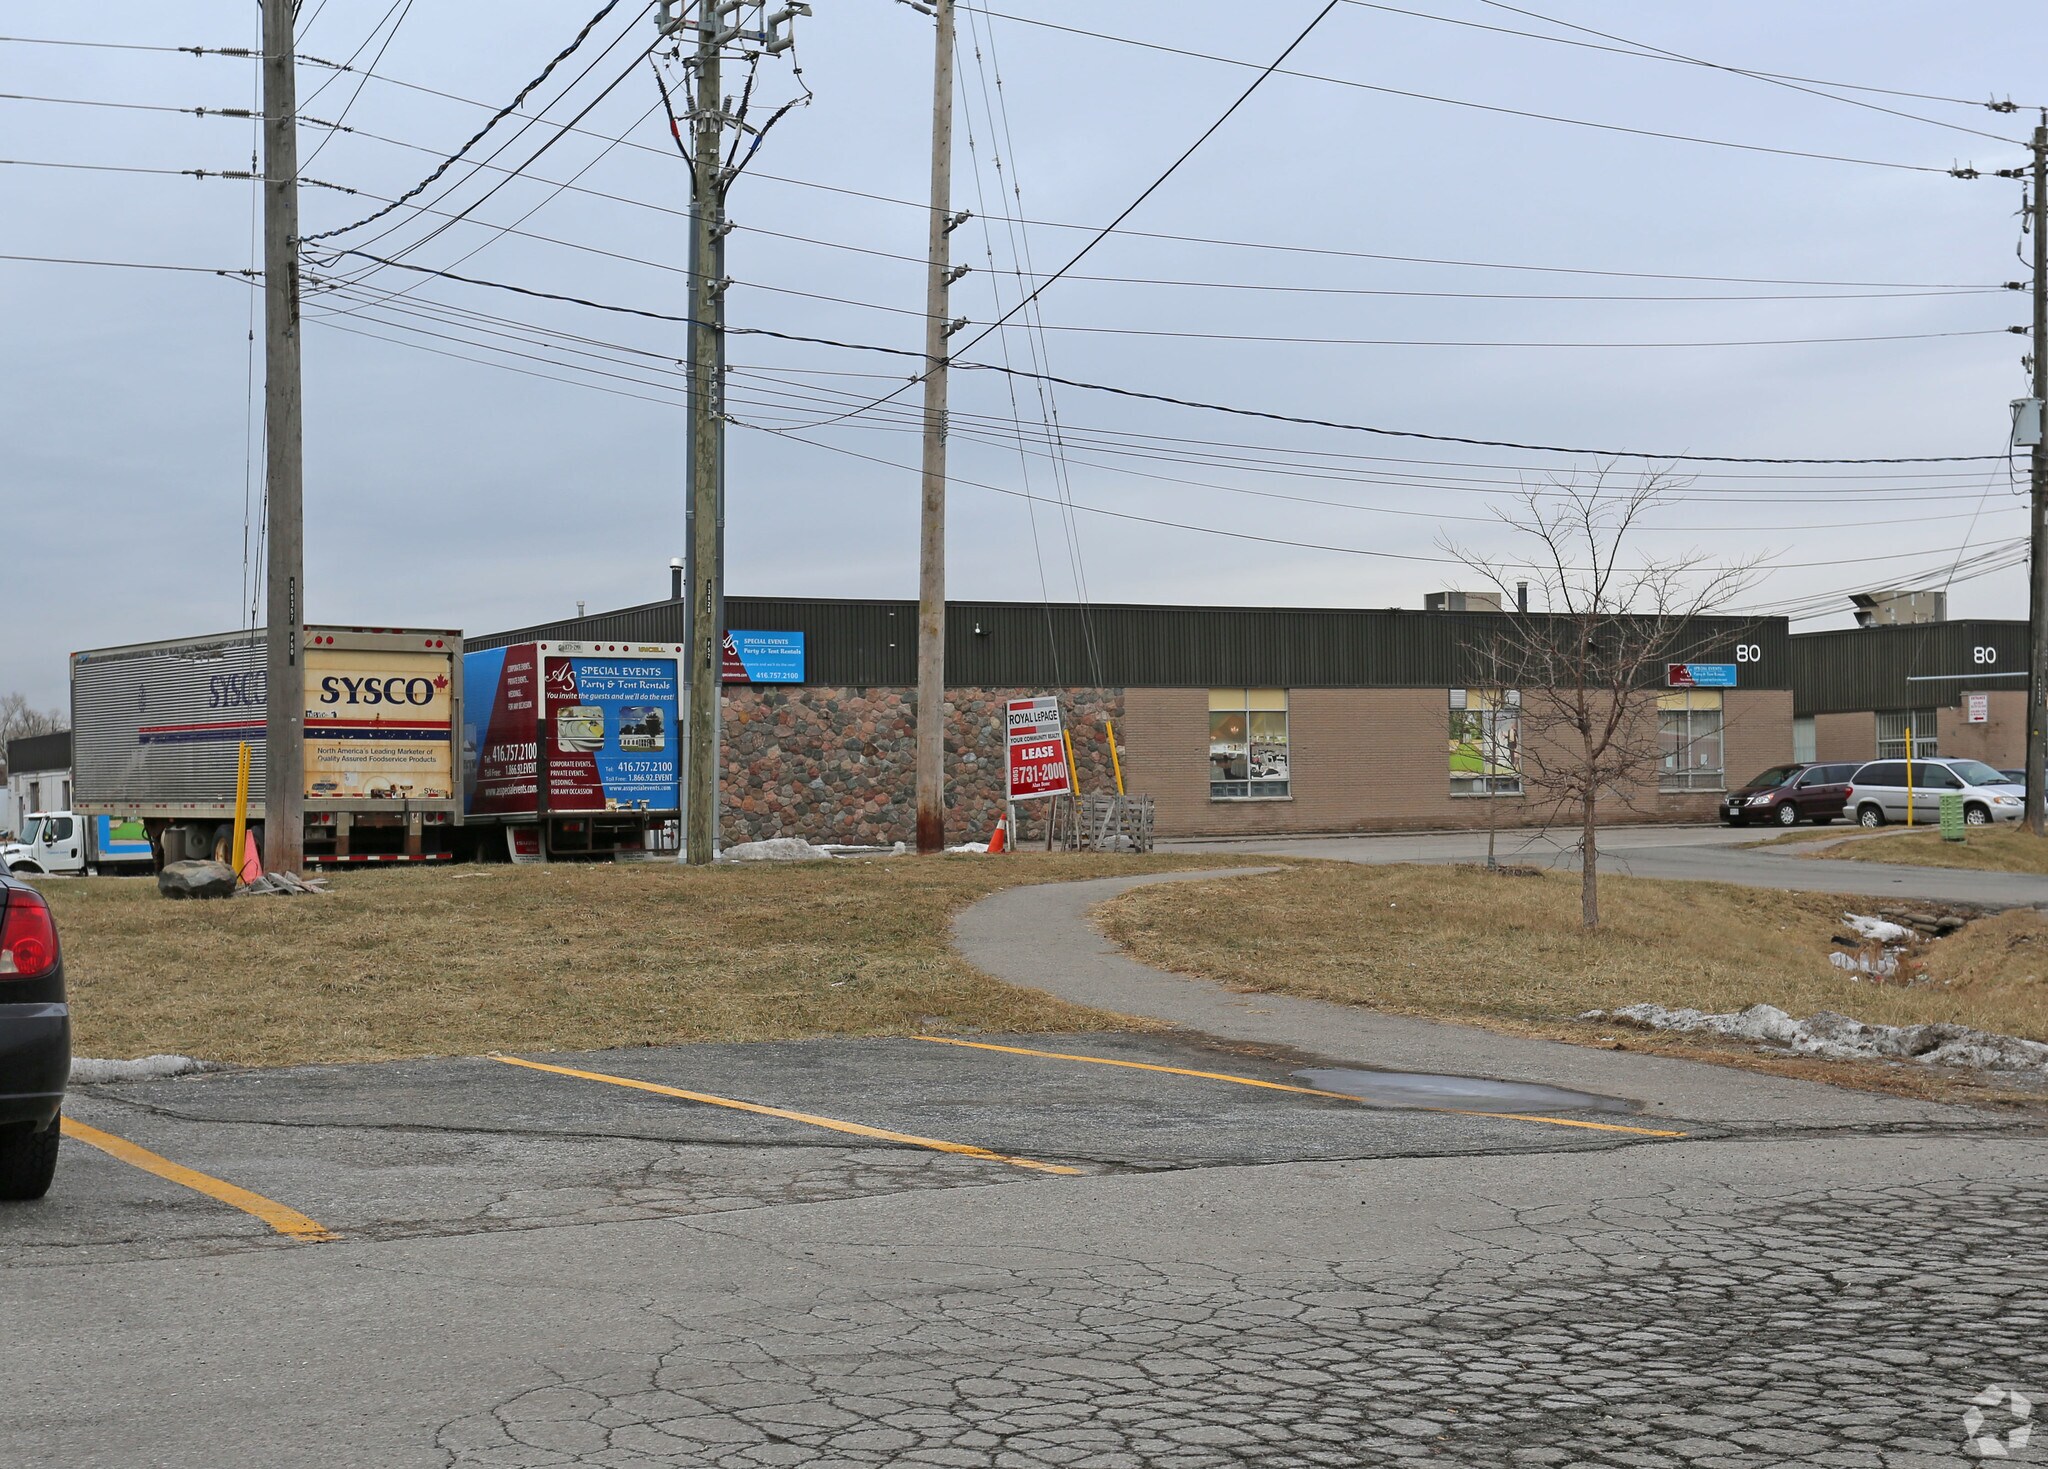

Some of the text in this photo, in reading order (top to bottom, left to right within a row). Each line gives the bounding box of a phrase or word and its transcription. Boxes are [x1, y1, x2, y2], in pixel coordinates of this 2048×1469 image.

[1736, 644, 1761, 662] 80
[1974, 647, 1996, 664] 80
[581, 666, 619, 676] SPECIAL
[622, 667, 661, 676] EVENTS
[320, 676, 434, 706] SYSCO
[581, 680, 605, 690] Party
[640, 680, 670, 689] Rentals
[590, 693, 610, 701] guests
[1009, 712, 1033, 725] ROYAL
[492, 742, 538, 762] 416.757.2100
[1022, 746, 1054, 760] LEASE
[618, 762, 673, 772] 416.757.2100
[1019, 762, 1064, 784] 731-2000
